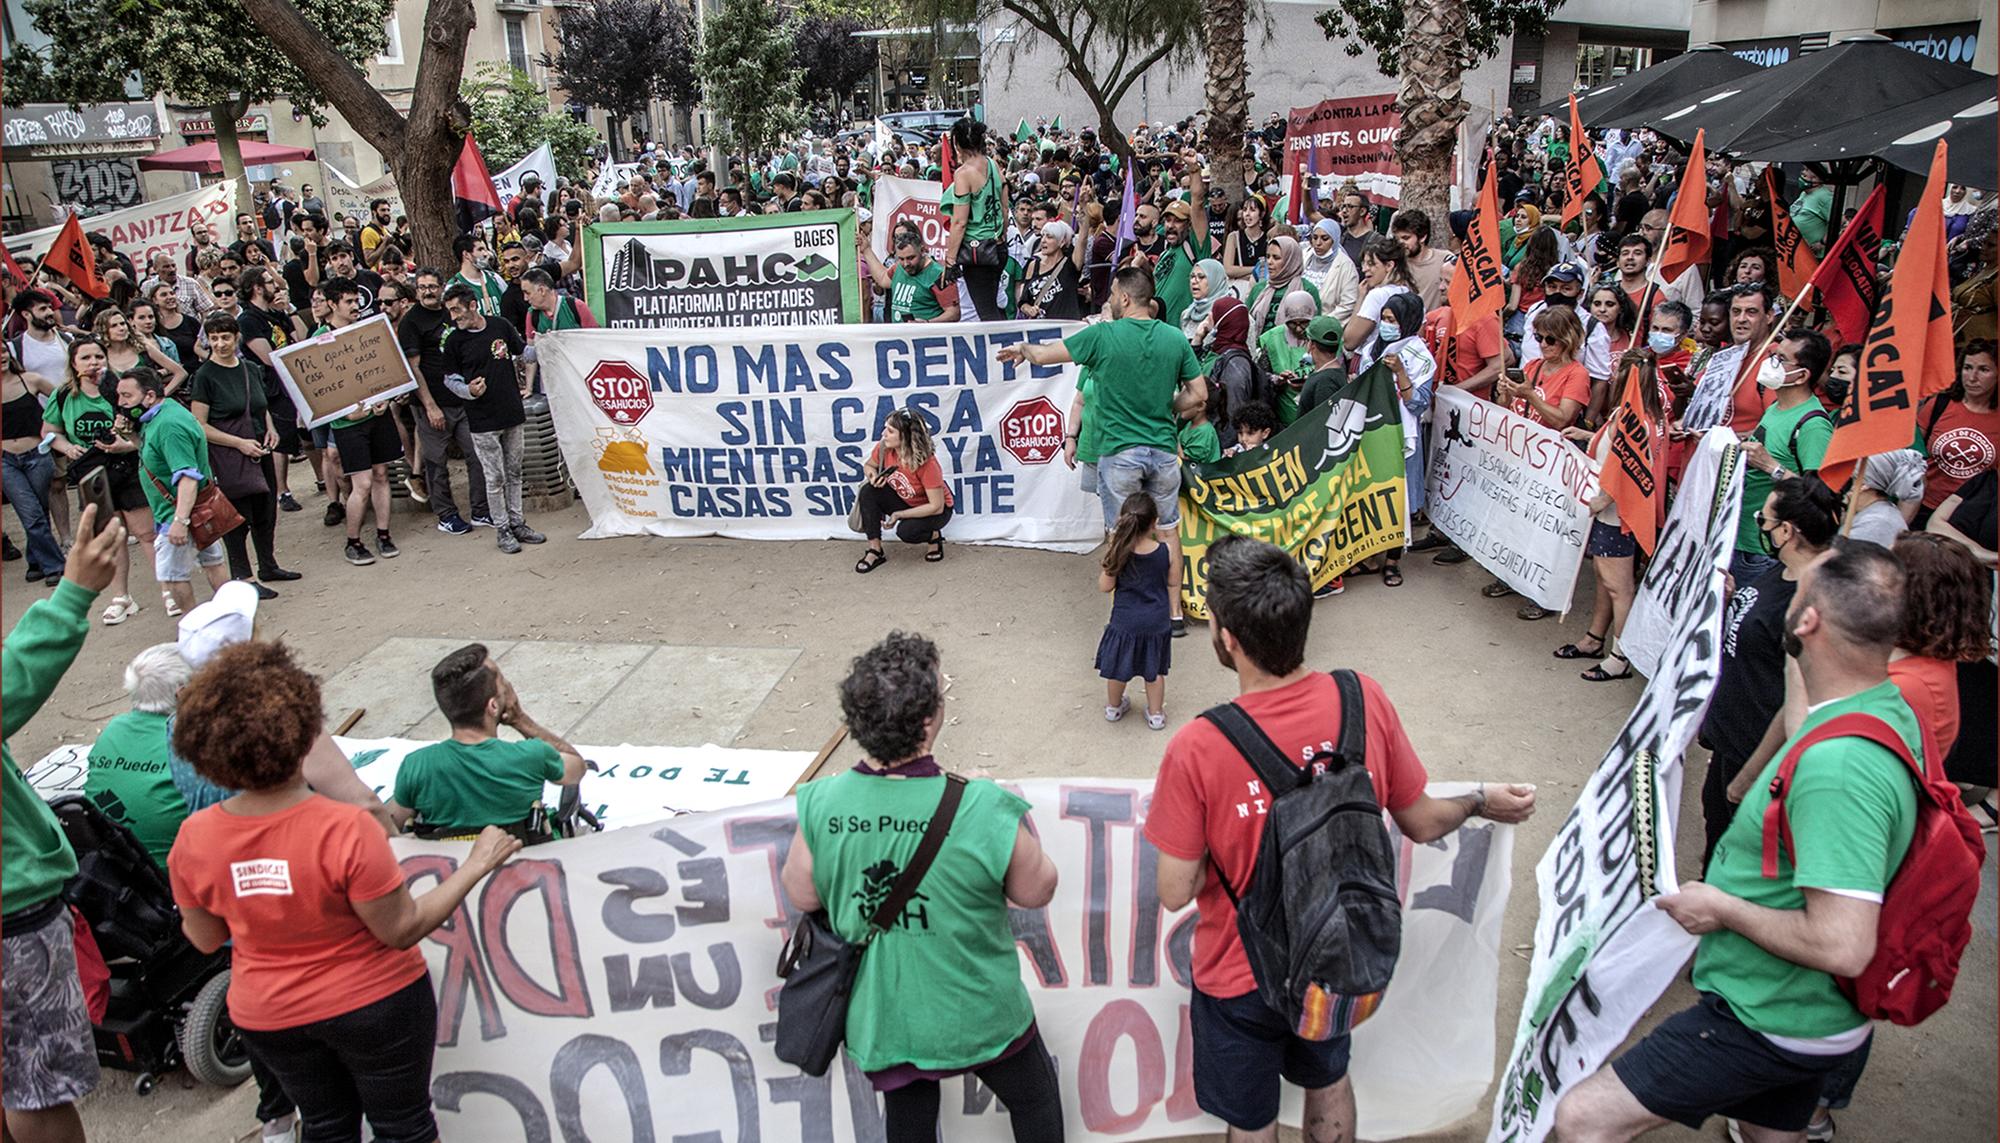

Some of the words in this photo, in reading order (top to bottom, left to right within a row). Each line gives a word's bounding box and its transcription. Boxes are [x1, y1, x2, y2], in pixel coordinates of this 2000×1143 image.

[1365, 105, 1379, 116] LA
[916, 203, 936, 215] PAH
[794, 228, 835, 248] BAGES
[653, 252, 798, 288] PAHC
[634, 293, 724, 315] PLATAFORMA
[727, 288, 814, 311] D'AFECTADES
[751, 308, 838, 328] CAPITALISME
[646, 345, 718, 393] NO
[733, 342, 853, 394] MAS
[875, 328, 1063, 389] GENTE
[592, 377, 644, 398] STOP
[716, 398, 806, 445] SIN
[831, 389, 983, 443] CASA
[1007, 414, 1058, 437] STOP
[1009, 435, 1060, 448] DESAHUCIOS
[663, 445, 865, 485] MIENTRAS
[942, 435, 1003, 474] YA
[1468, 402, 1600, 506] BLACKSTONE
[669, 484, 792, 517] CASAS
[945, 474, 1015, 515] NTE
[97, 756, 112, 769] Se
[113, 757, 167, 774] Puede!
[598, 765, 680, 779] DOY
[704, 767, 751, 785] TE
[848, 815, 871, 832] Se
